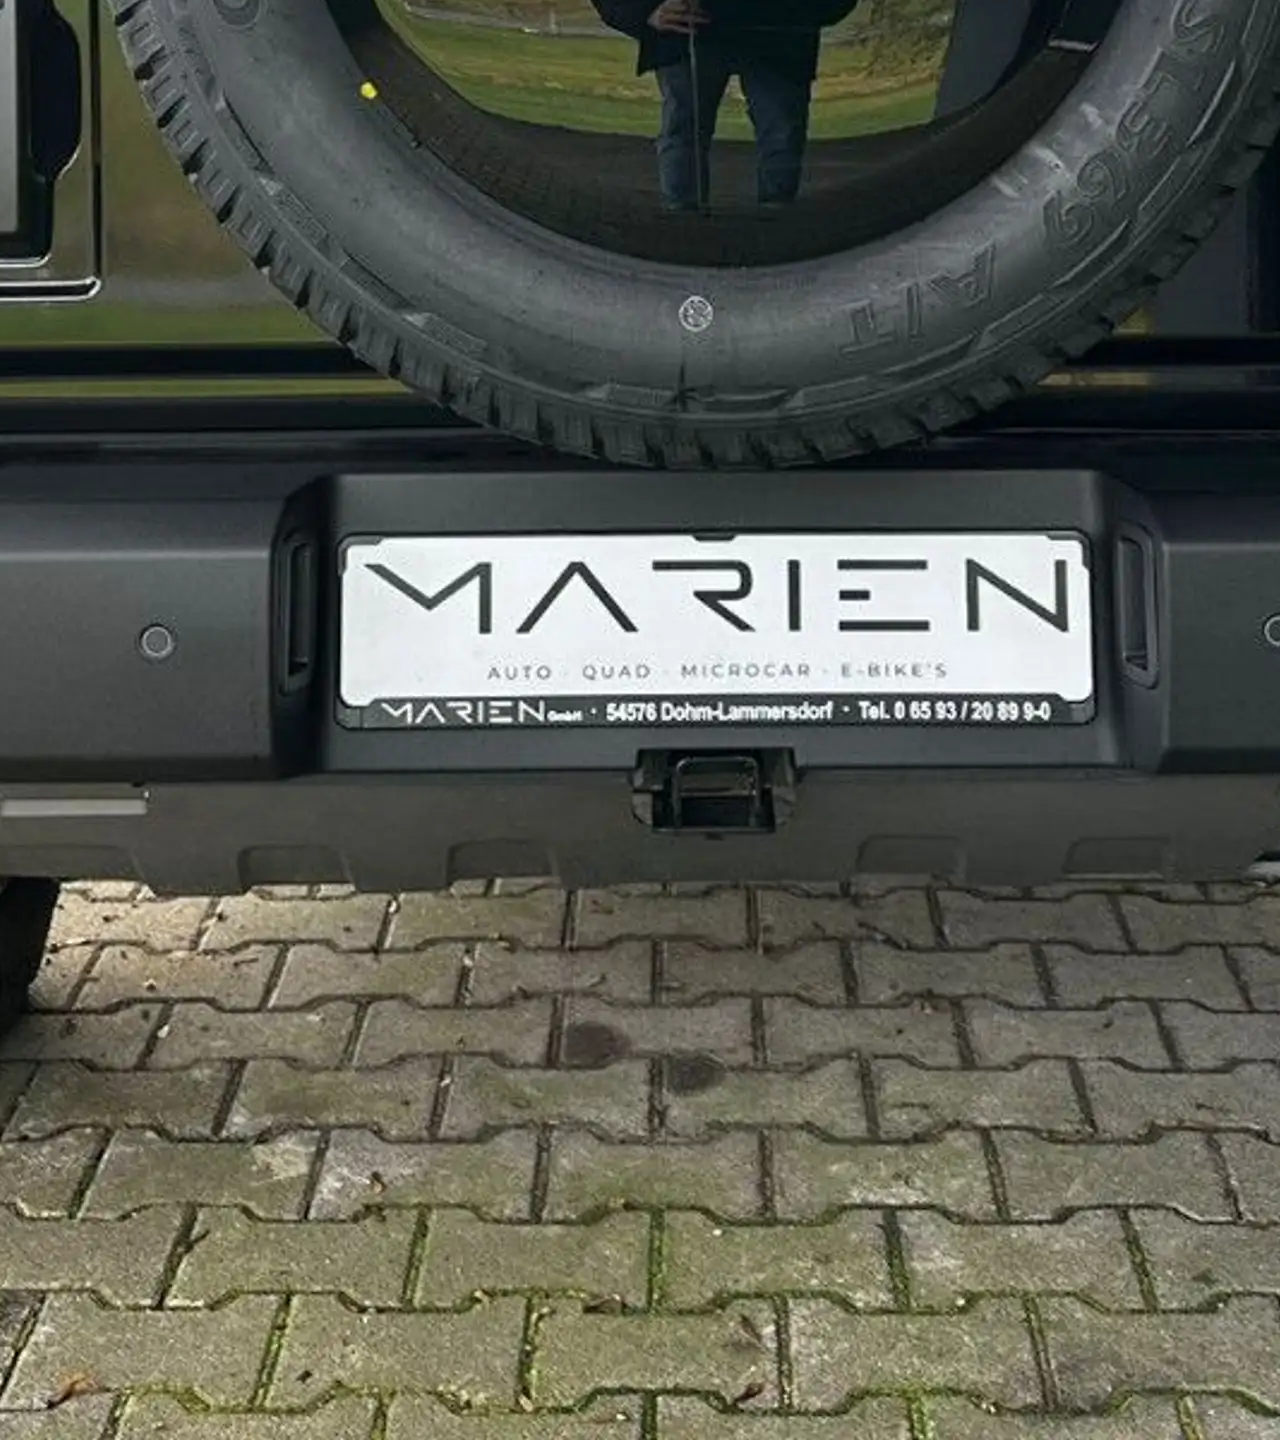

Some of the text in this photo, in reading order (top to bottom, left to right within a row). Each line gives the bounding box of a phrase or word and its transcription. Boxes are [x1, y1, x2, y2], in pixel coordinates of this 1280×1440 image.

[363, 558, 1069, 635] MARIEN
[487, 662, 948, 681] AUTO QUAD MICROCAR E-BIKE'S
[380, 699, 545, 724] MARIEN
[606, 702, 658, 722] 54576
[660, 701, 833, 722] Dohm-Lammersdorf
[858, 700, 890, 721] Tel.
[894, 701, 906, 721] 0
[909, 701, 932, 721] 65
[935, 701, 958, 721] 93
[972, 701, 995, 721] 20
